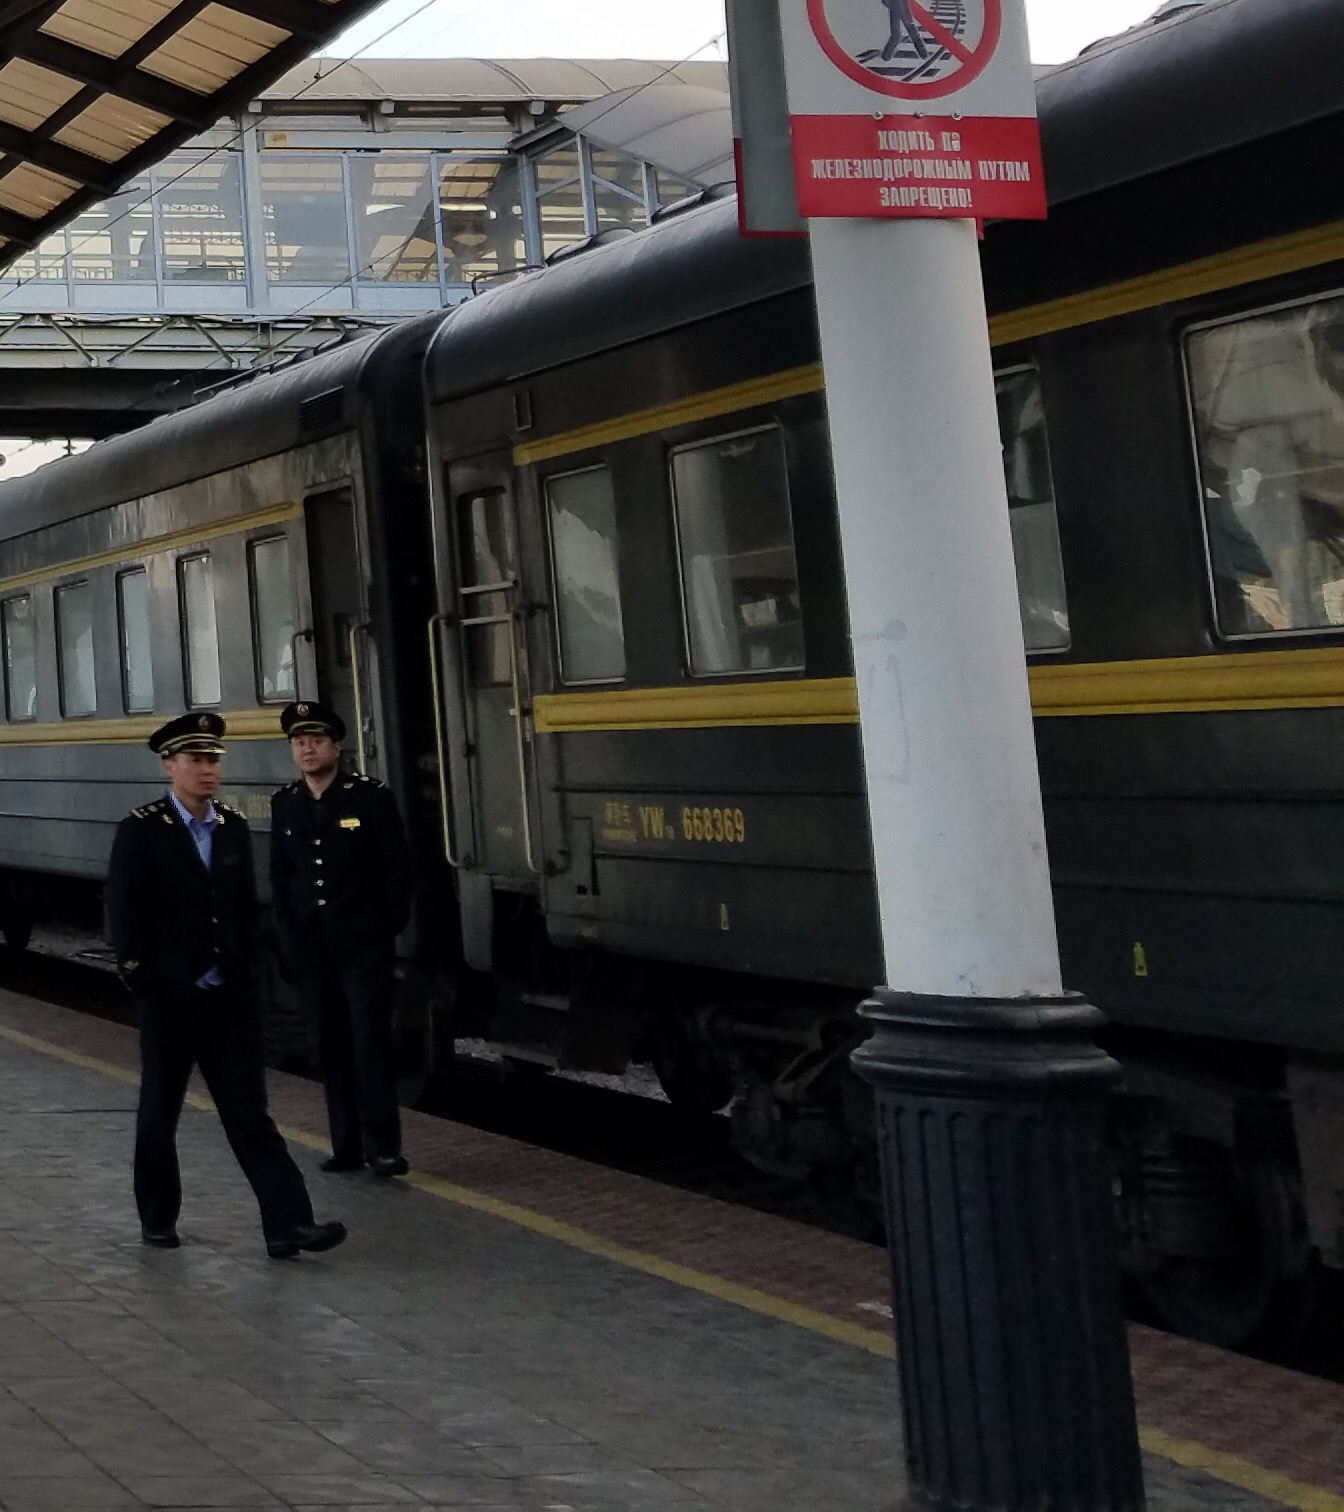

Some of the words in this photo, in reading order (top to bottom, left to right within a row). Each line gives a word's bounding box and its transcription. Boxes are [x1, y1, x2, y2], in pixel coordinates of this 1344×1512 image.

[877, 130, 935, 154] ХОДИТЬ
[811, 158, 973, 181] ЖЕЛЕЗНОДОРОЖНЫМ
[978, 160, 1031, 182] ПУТЯМ
[879, 186, 973, 210] ЗАПРЕЩЕНО!
[682, 807, 745, 843] 668369
